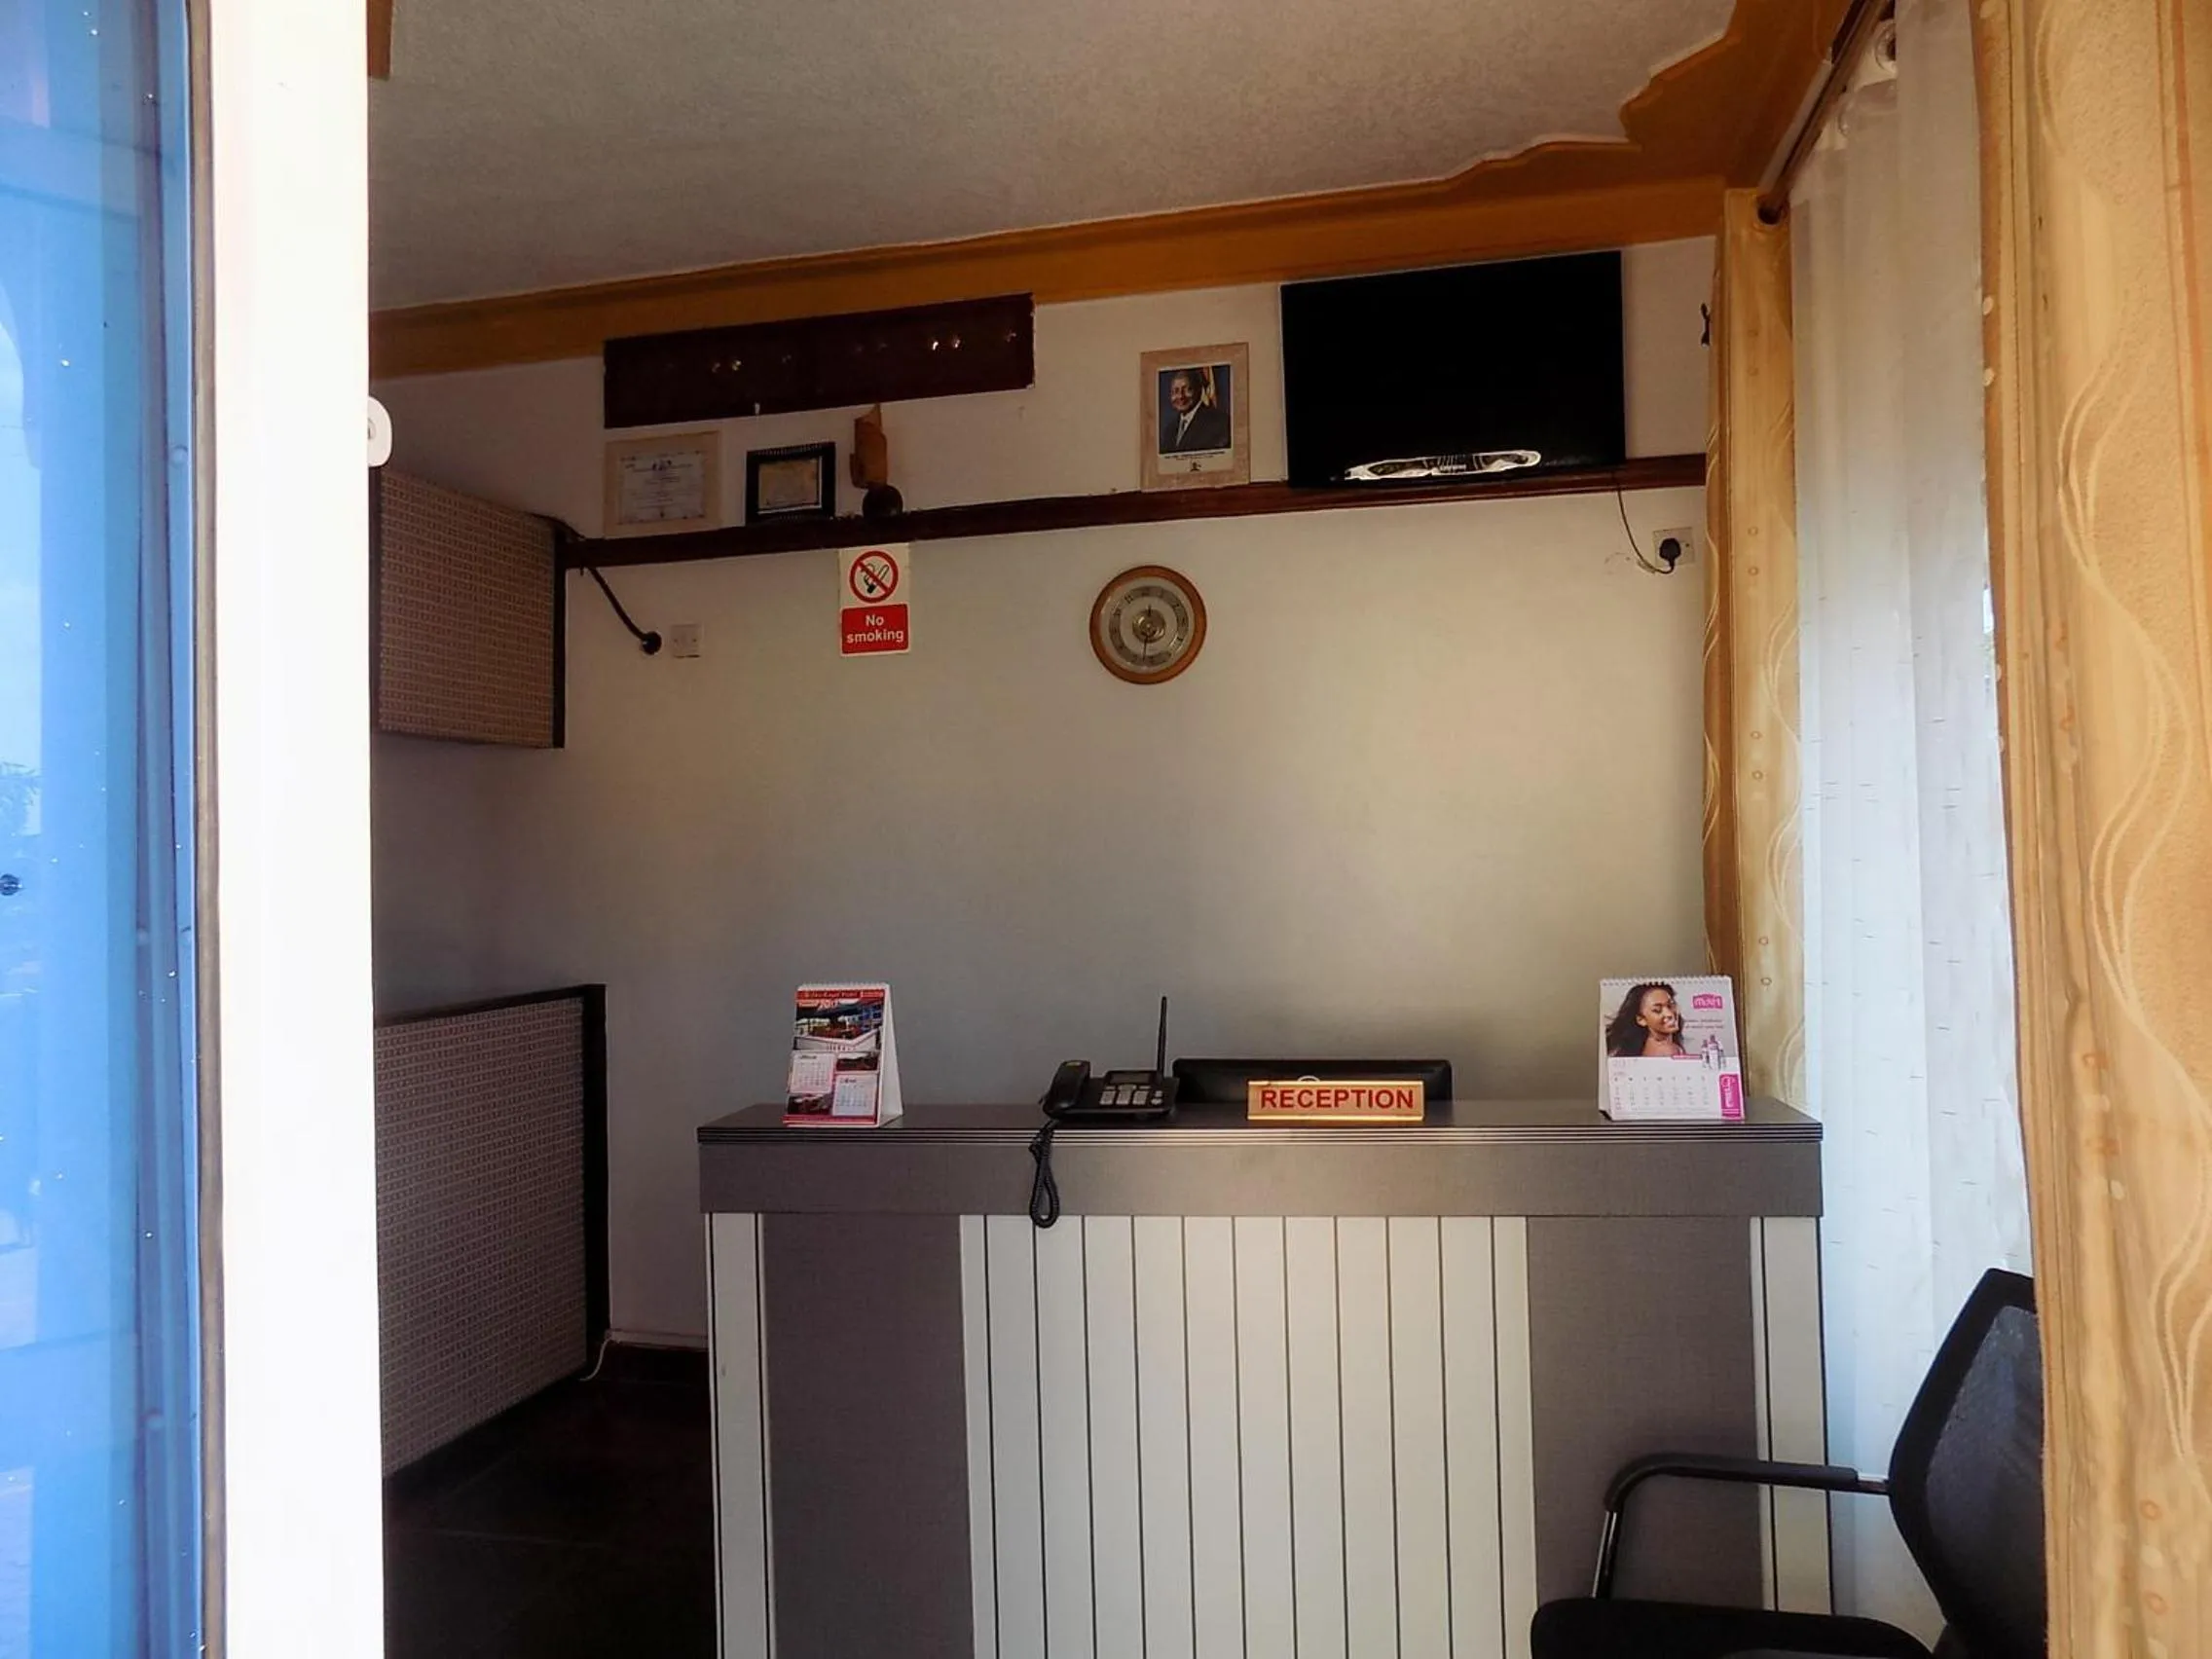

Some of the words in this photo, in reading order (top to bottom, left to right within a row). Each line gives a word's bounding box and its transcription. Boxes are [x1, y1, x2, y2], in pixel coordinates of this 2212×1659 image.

[866, 614, 884, 626] No
[847, 629, 903, 643] smoking
[1260, 1088, 1414, 1109] RECEPTION
